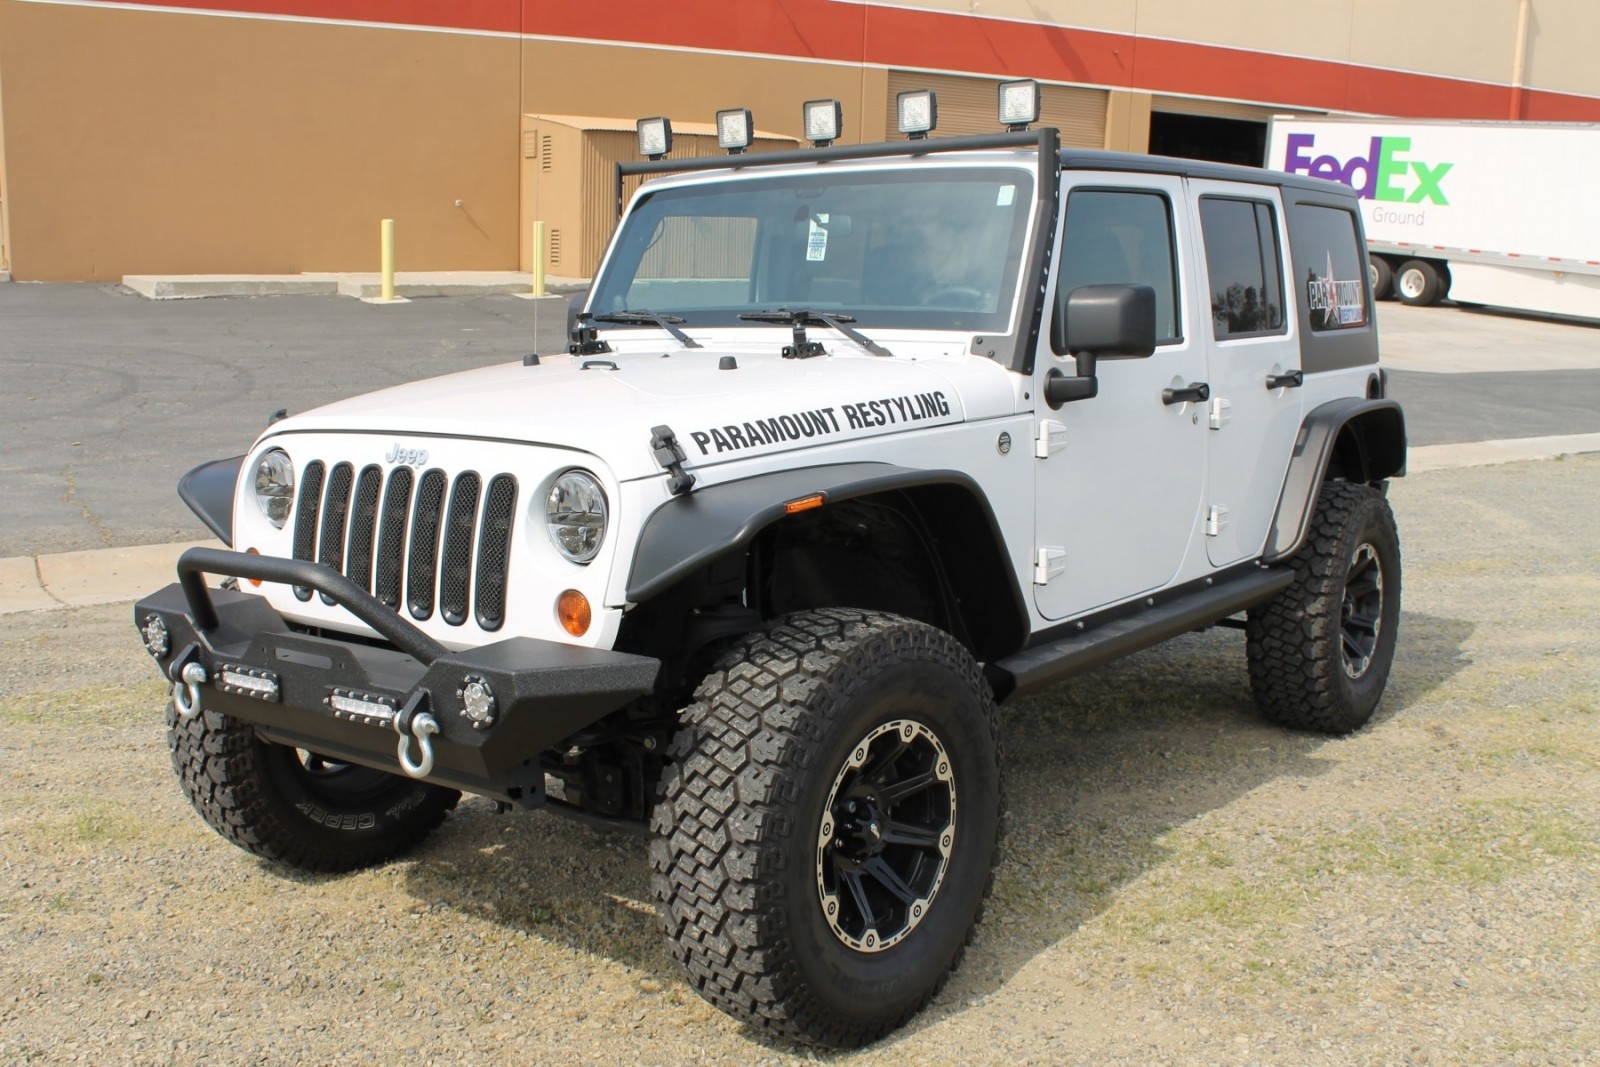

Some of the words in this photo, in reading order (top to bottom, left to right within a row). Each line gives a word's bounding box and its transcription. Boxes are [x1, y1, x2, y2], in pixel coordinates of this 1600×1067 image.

[1285, 133, 1454, 206] FedEx
[1373, 207, 1426, 226] Ground
[690, 407, 841, 455] PARAMOUNT
[841, 391, 950, 429] RESTYLING
[386, 444, 428, 469] Jeep
[295, 799, 376, 830] CEPEK
